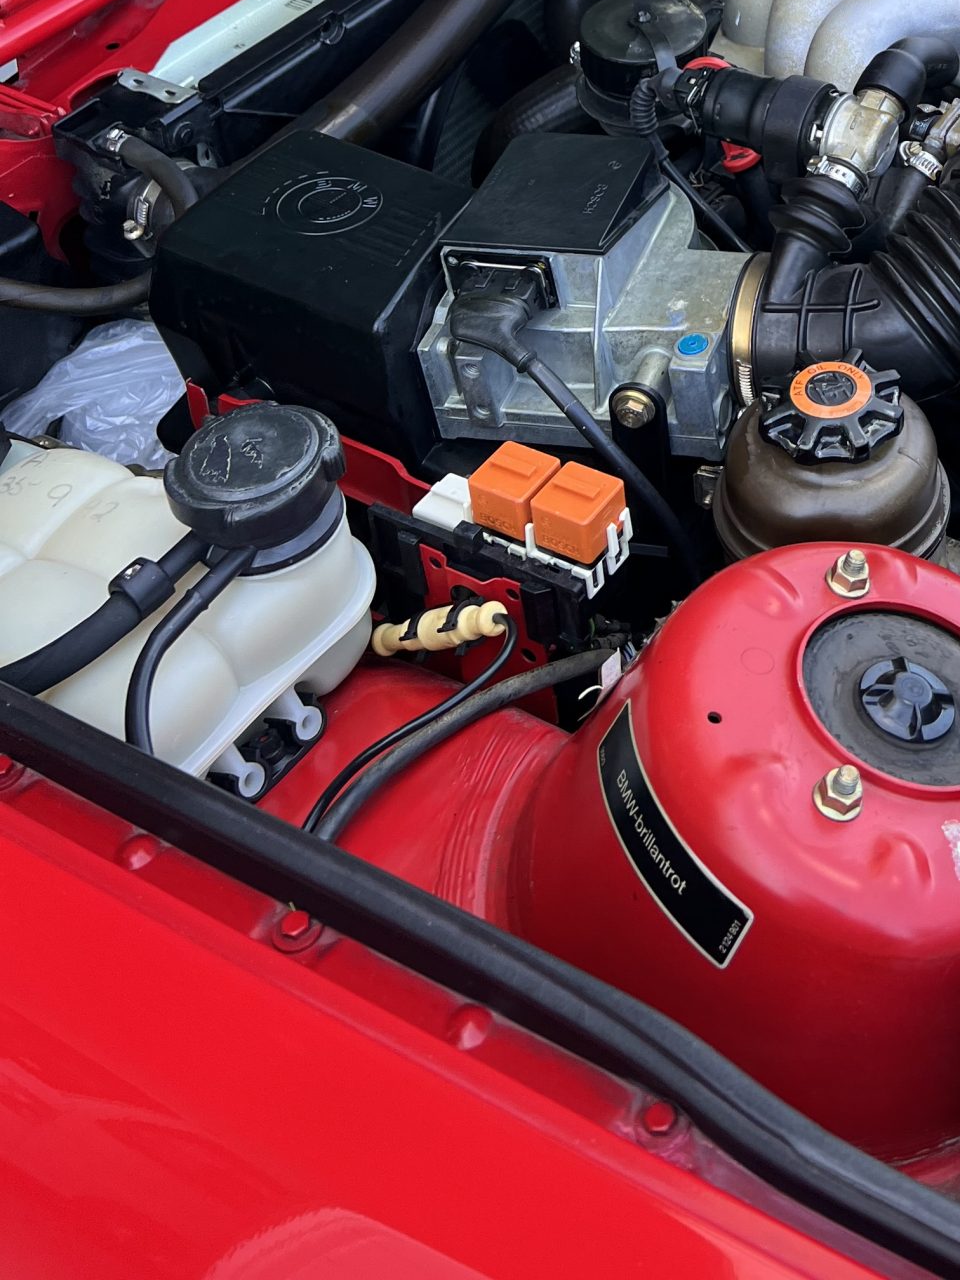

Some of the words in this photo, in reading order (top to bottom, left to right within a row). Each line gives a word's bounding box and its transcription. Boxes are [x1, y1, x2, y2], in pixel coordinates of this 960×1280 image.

[582, 183, 609, 215] BOSCH
[792, 379, 804, 397] ATF
[807, 365, 827, 376] OIL
[837, 364, 864, 381] ONLY
[616, 768, 687, 896] BMW-brillantrot
